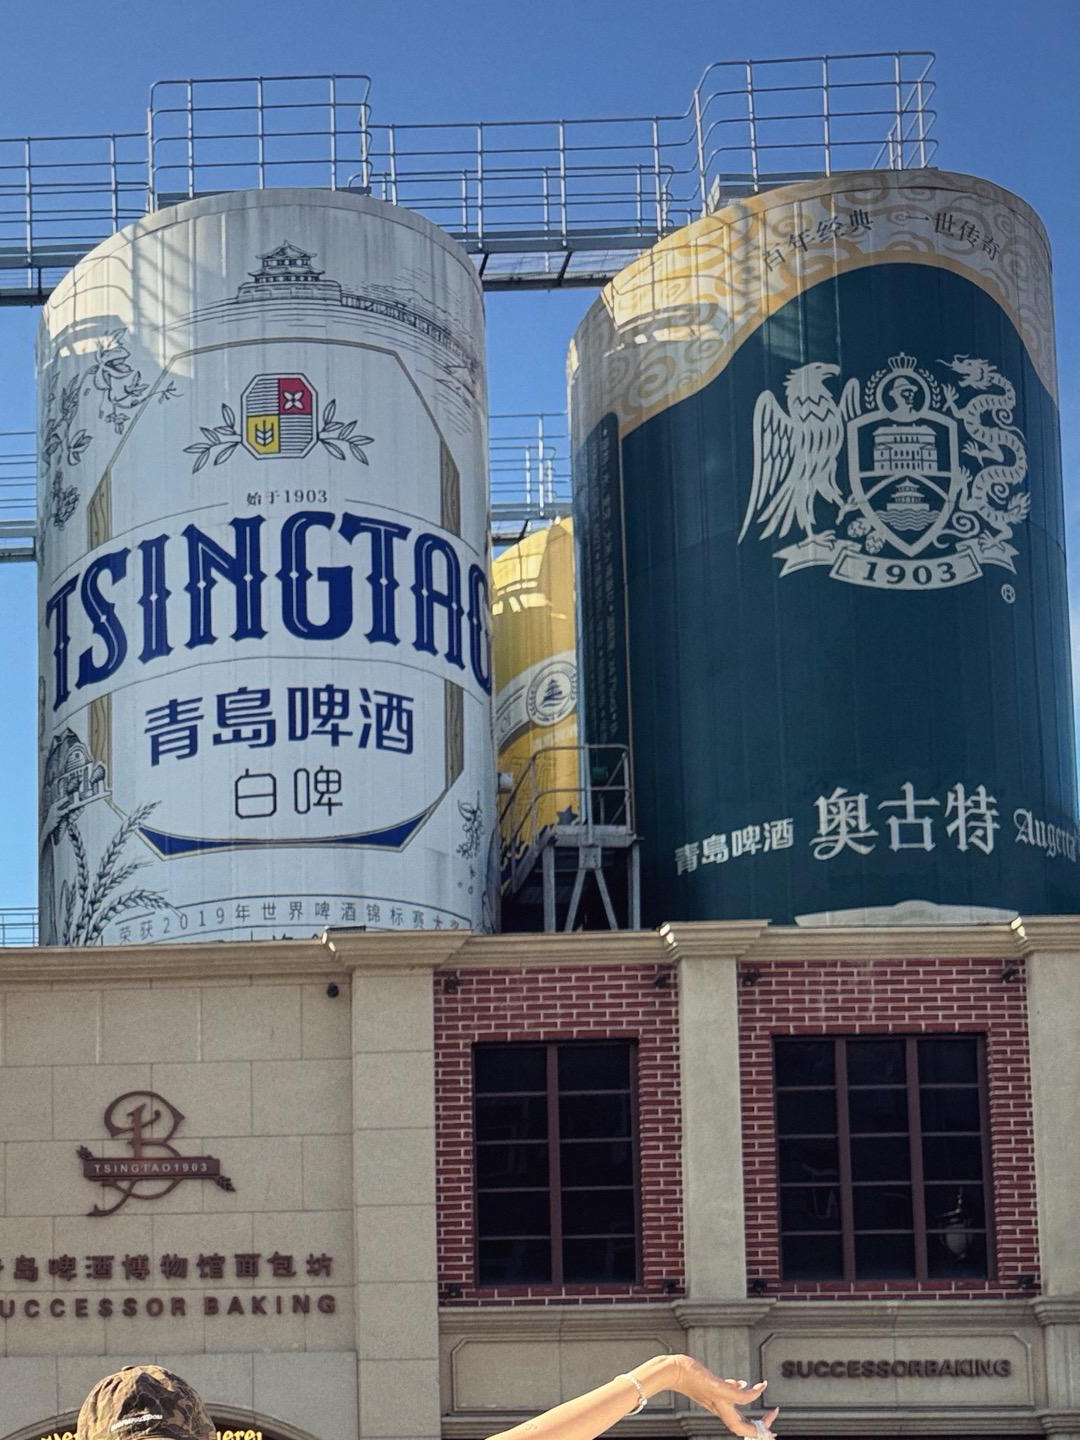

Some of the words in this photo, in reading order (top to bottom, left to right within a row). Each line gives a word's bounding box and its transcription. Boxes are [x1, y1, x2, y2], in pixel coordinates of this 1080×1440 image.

[763, 209, 873, 272] 百年经典
[862, 561, 957, 586] 1903
[44, 510, 493, 713] TSINGTAO
[144, 684, 414, 767] 青島啤酒
[234, 766, 344, 820] 白啤
[673, 817, 795, 876] 青島啤酒
[809, 781, 1000, 860] 奥古特
[204, 1294, 336, 1316] BAKING
